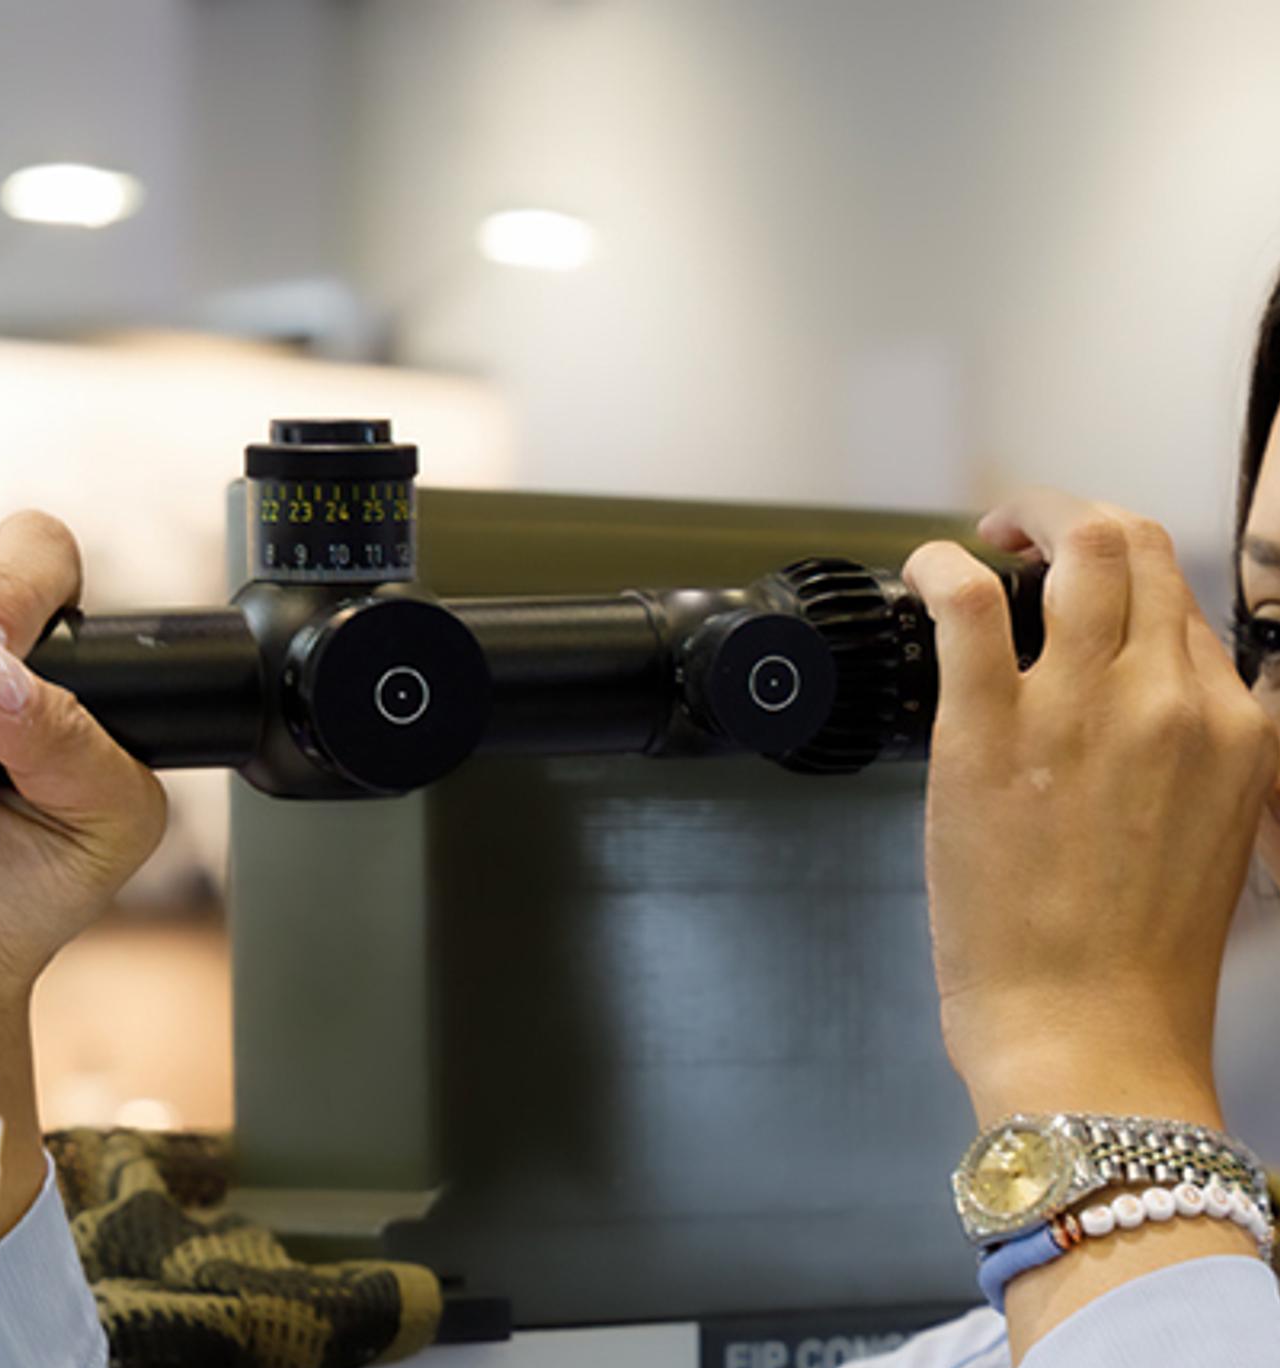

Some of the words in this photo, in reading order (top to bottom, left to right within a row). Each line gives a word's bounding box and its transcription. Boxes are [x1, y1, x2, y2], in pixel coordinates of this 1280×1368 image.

[261, 500, 279, 522] 22
[289, 501, 313, 522] 23
[326, 501, 349, 522] 24
[363, 501, 384, 522] 25
[294, 543, 308, 566] 9
[329, 543, 351, 566] 10
[364, 543, 382, 565] 11
